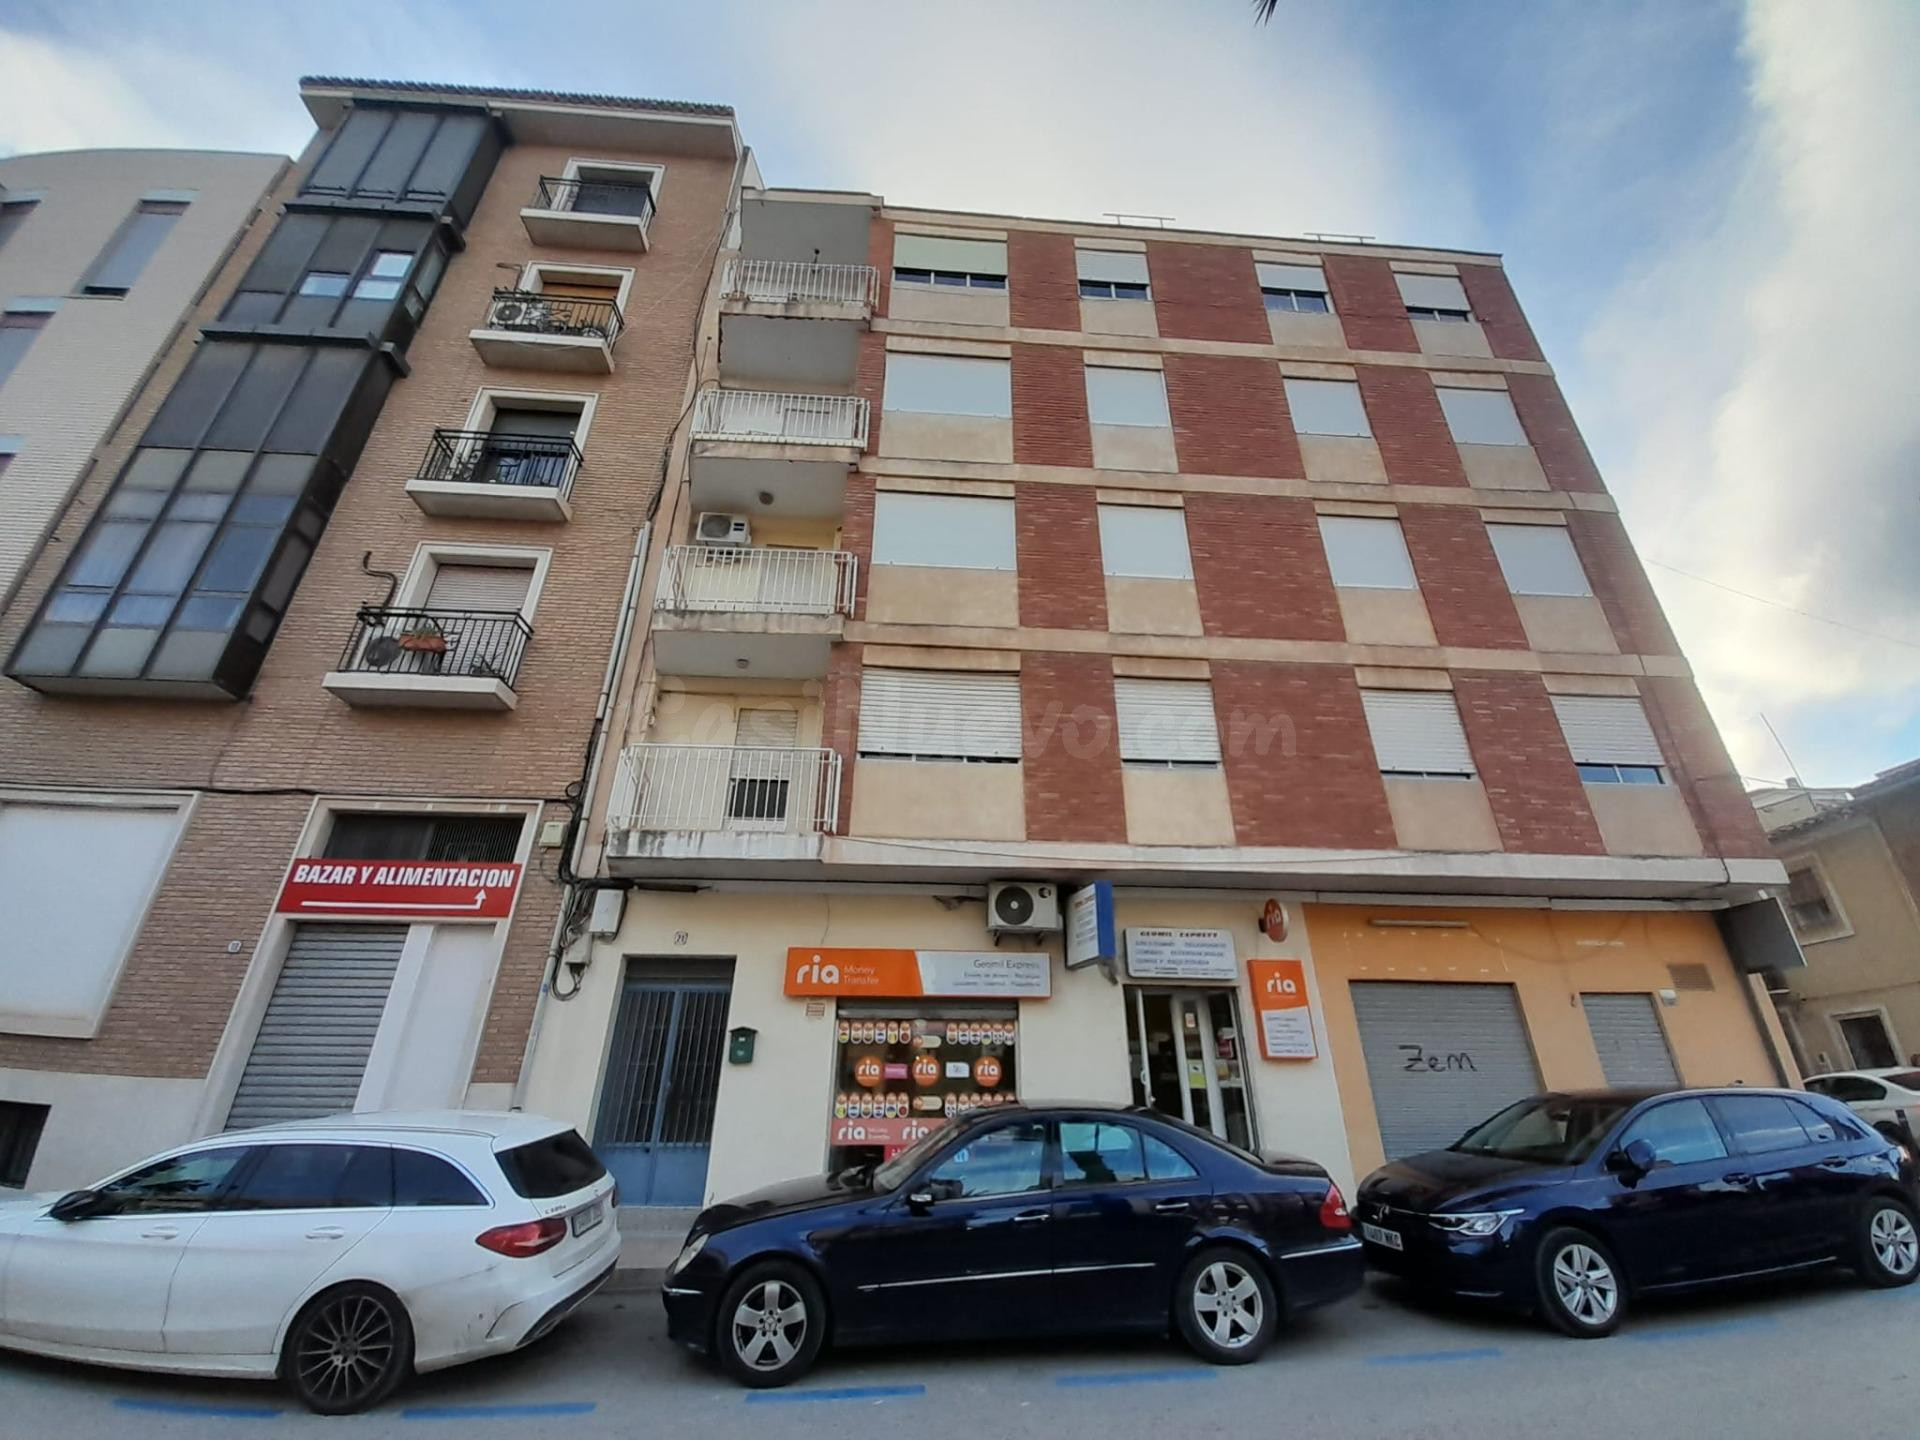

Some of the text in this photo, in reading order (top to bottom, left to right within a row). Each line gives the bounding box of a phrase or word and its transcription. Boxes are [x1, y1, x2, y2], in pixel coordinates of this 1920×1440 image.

[293, 864, 515, 888] BAZAR Y ALIMENTACION
[796, 954, 840, 984] ria
[844, 964, 876, 975] Money
[1266, 972, 1297, 993] ria
[858, 1060, 881, 1075] ria
[915, 1058, 937, 1074] ria
[977, 1060, 999, 1075] ria
[838, 1120, 866, 1140] ria
